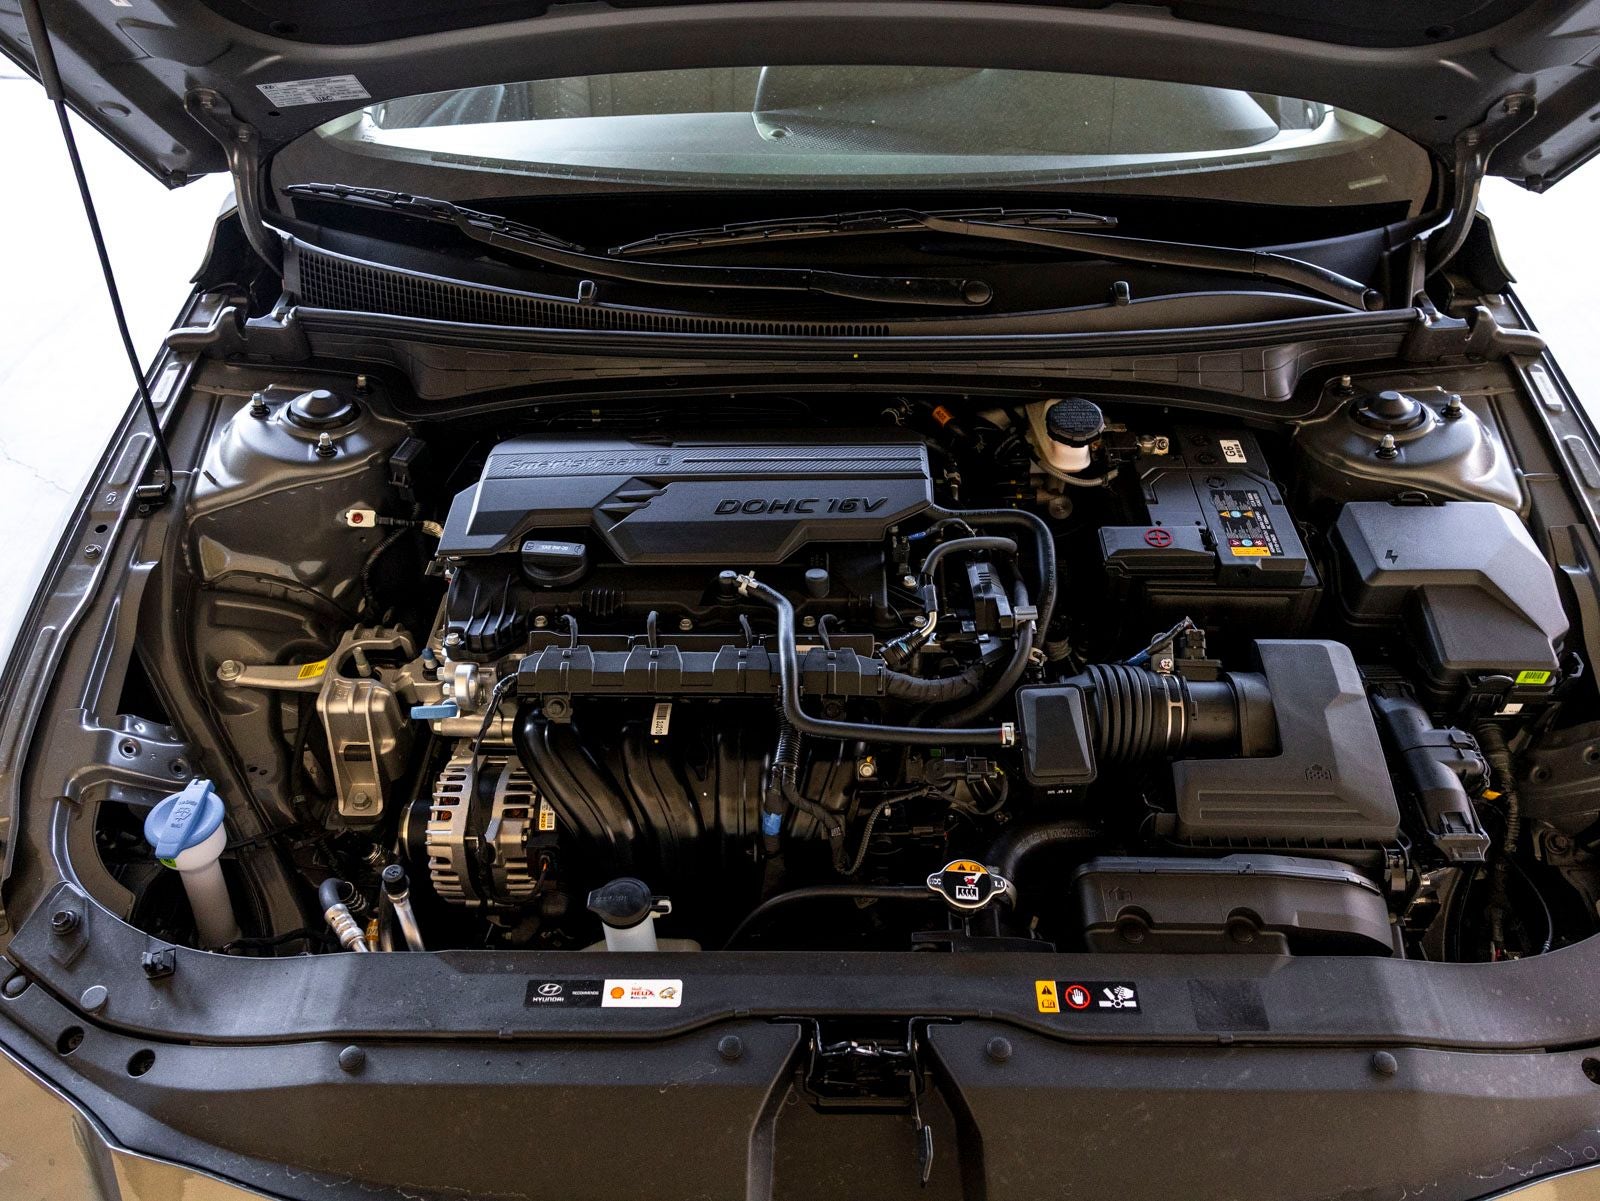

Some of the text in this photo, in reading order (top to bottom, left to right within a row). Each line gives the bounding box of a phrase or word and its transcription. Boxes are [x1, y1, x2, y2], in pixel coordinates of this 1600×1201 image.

[1223, 445, 1236, 457] G6
[504, 456, 650, 470] Smartstream
[713, 496, 889, 515] DOHC 16V
